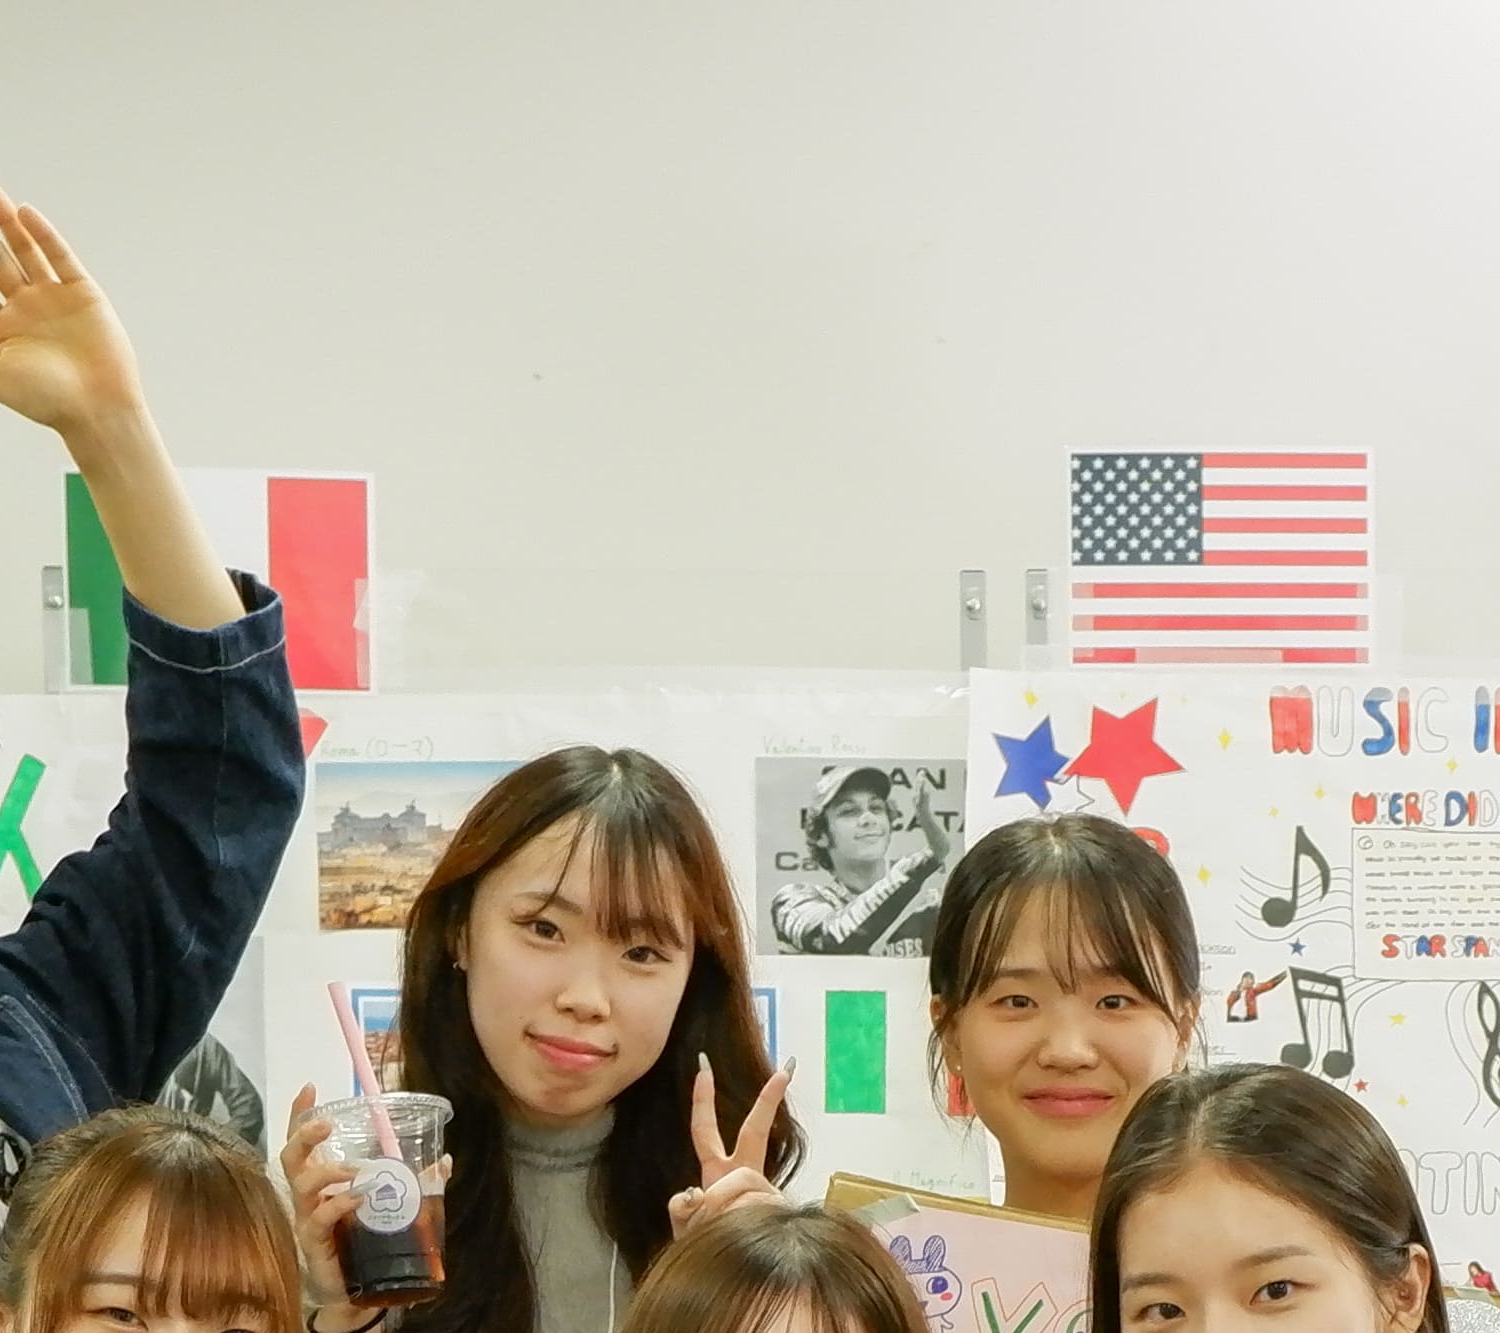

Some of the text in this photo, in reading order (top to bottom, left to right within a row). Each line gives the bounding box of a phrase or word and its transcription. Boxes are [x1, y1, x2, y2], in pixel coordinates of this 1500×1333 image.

[1269, 684, 1450, 757] MUSIC
[1444, 790, 1499, 827] DID
[1381, 934, 1447, 959] STAR
